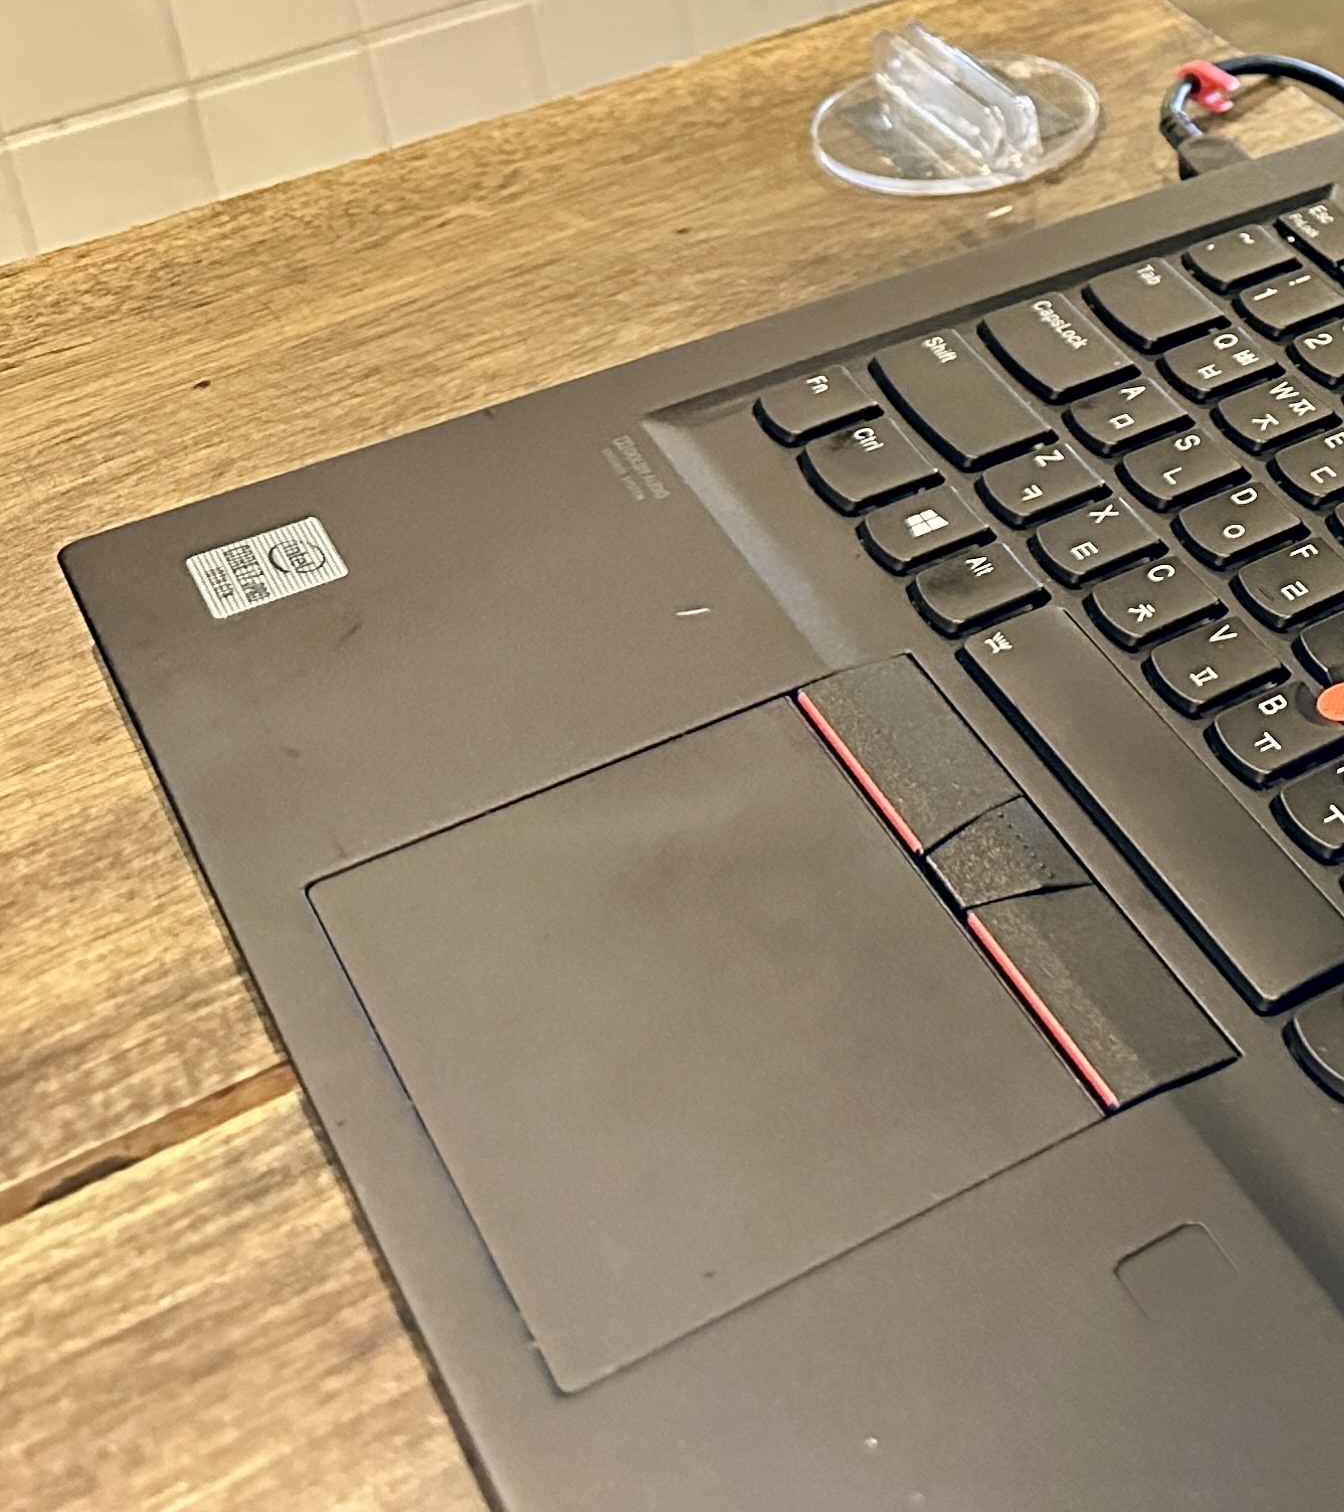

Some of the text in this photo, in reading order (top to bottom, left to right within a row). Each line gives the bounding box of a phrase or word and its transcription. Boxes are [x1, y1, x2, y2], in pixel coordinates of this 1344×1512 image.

[1137, 265, 1161, 285] Tab
[1289, 275, 1310, 286] !
[1254, 288, 1277, 300] 1
[1214, 334, 1238, 349] Q
[1304, 334, 1332, 349] 2
[923, 337, 956, 363] Shift
[1198, 364, 1222, 379] ㅂ
[807, 376, 828, 393] Fn
[1270, 382, 1300, 401] W
[1121, 386, 1145, 400] A
[854, 428, 884, 451] Ctrl
[1175, 435, 1200, 450] S
[1035, 448, 1065, 467] Z
[1231, 488, 1257, 504] D
[1089, 505, 1119, 523] X
[281, 538, 316, 571] intel
[1290, 545, 1318, 557] F
[966, 557, 993, 576] Alt
[1148, 565, 1175, 581] C
[1209, 625, 1237, 641] V
[1259, 695, 1287, 715] B
